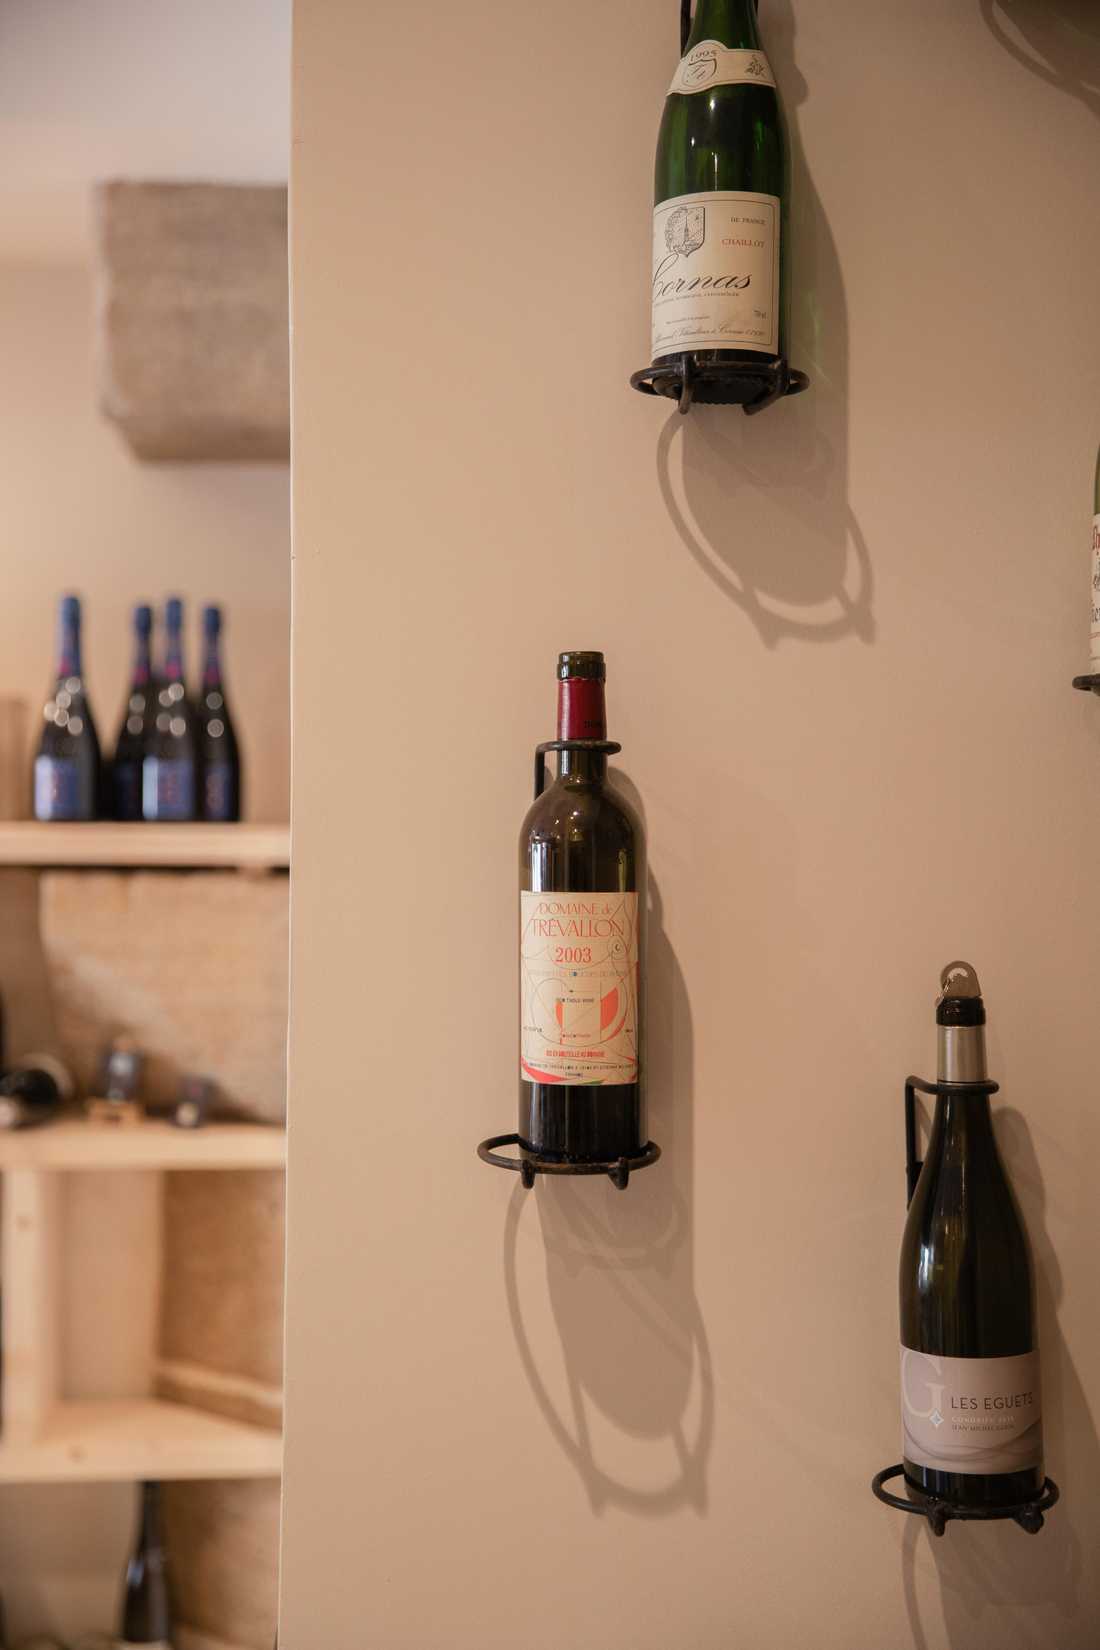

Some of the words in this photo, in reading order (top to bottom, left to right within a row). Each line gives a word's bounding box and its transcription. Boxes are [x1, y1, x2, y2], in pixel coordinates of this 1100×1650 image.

[539, 902, 597, 915] DOMAINE
[555, 946, 592, 963] 2003
[950, 1396, 978, 1410] LES
[983, 1391, 1033, 1410] EGUETS
